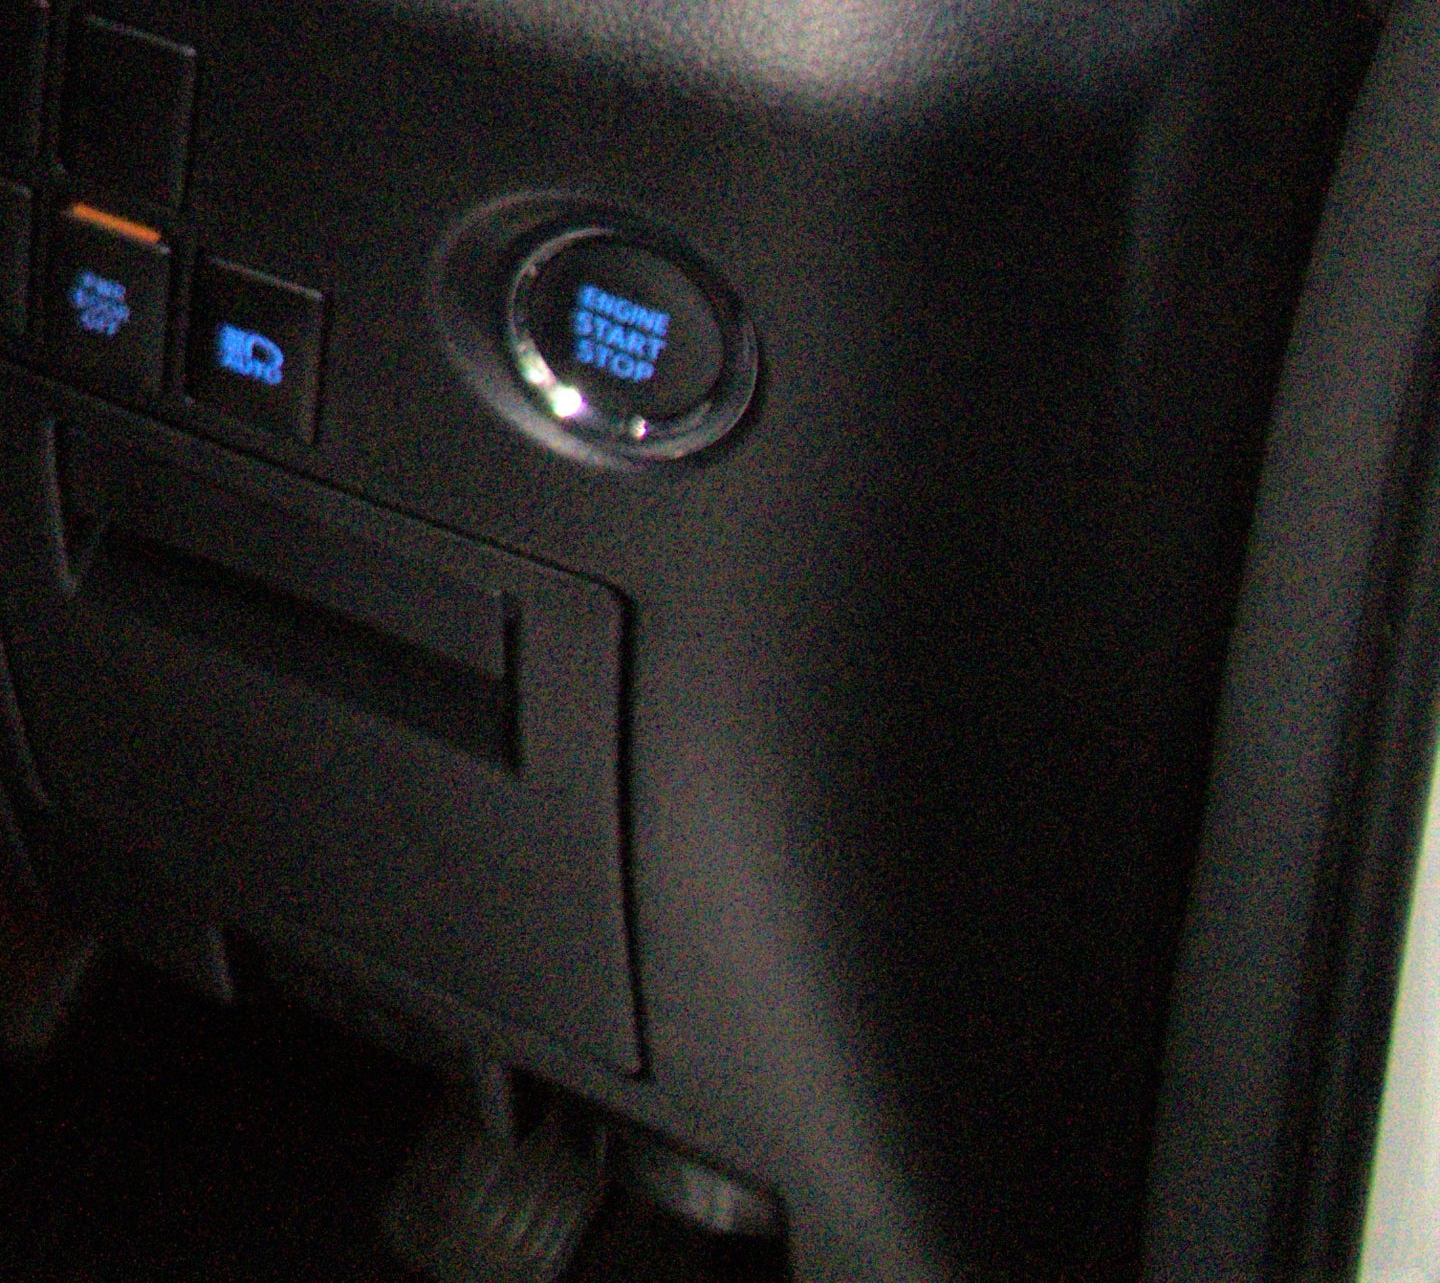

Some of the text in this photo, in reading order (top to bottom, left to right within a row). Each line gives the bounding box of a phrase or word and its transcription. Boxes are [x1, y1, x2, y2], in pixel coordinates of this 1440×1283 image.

[573, 309, 668, 361] START
[578, 285, 671, 337] ENGINE
[574, 337, 655, 383] STOP
